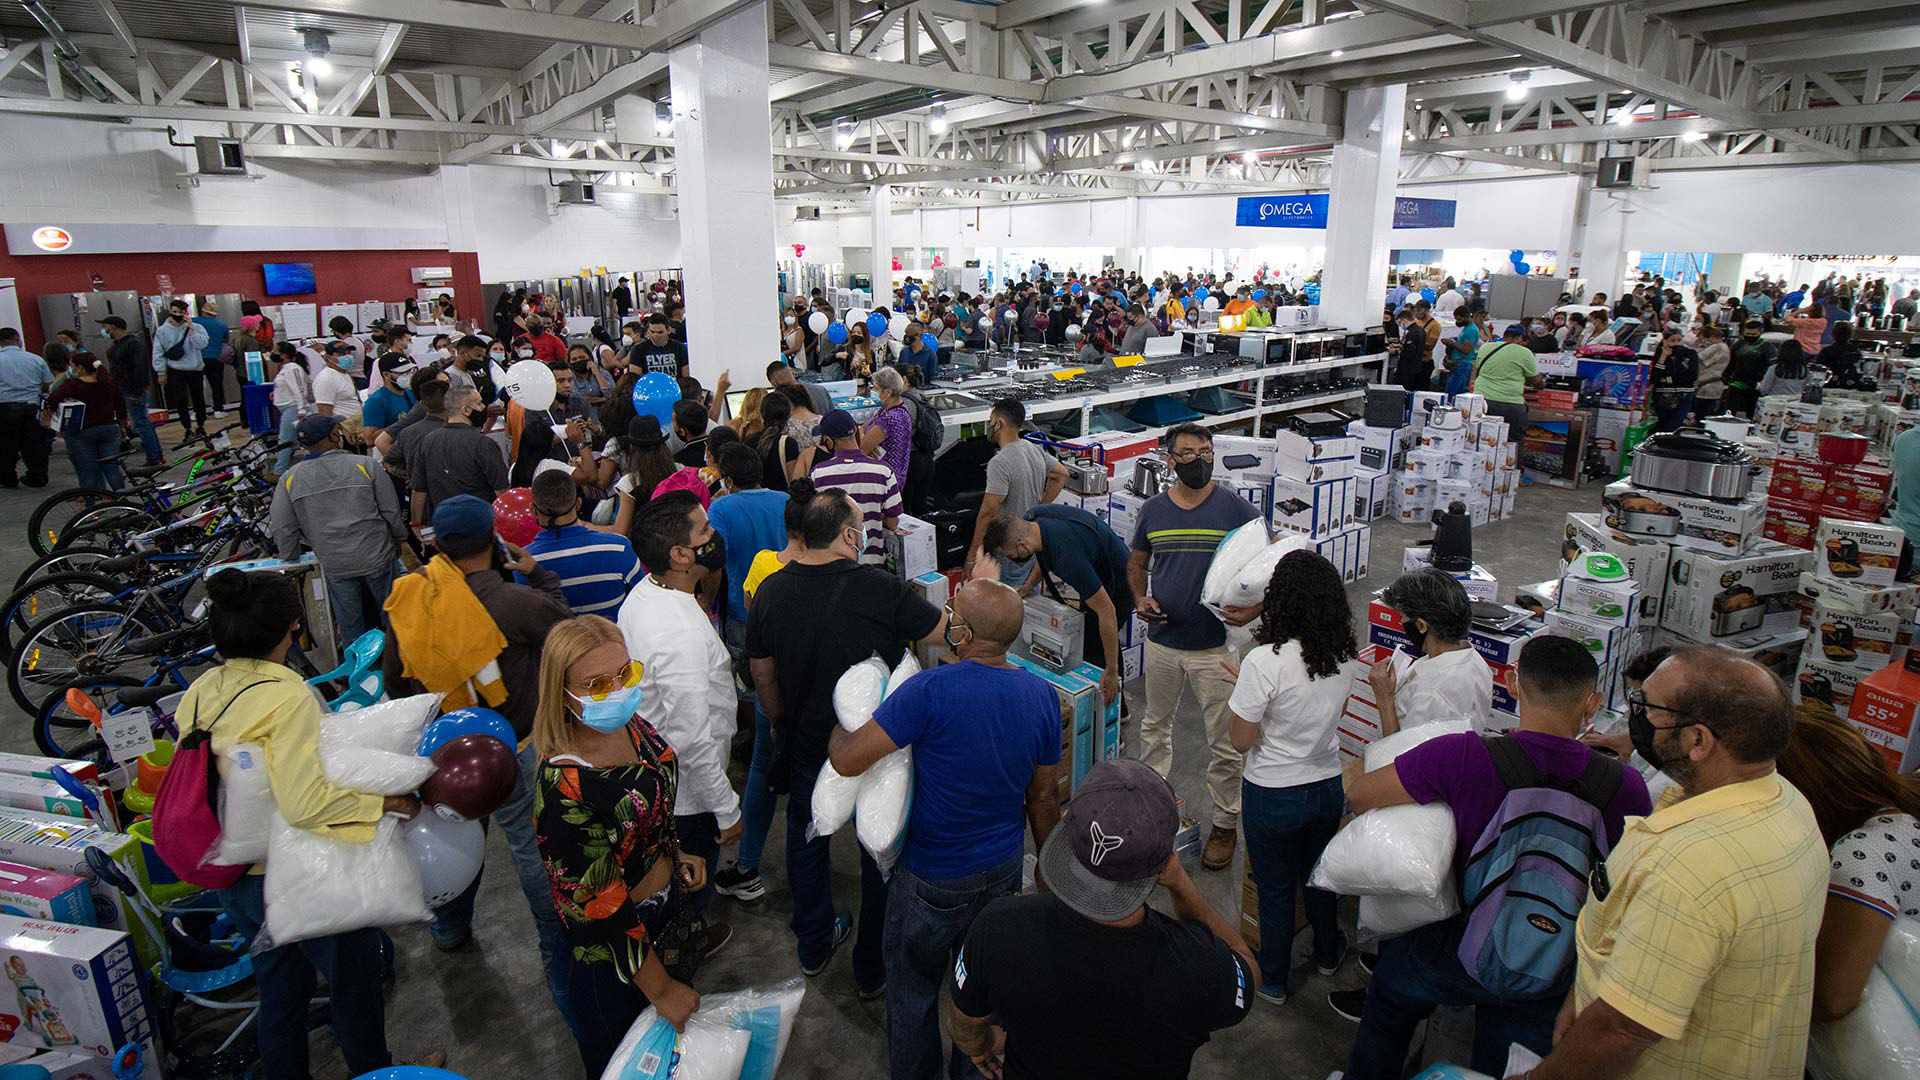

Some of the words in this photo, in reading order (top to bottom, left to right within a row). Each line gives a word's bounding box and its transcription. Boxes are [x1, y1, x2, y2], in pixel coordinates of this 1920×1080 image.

[646, 353, 676, 365] FLYER
[1678, 501, 1724, 515] Hamilton
[1703, 511, 1736, 523] Beach
[1832, 528, 1884, 540] Hamilton
[1860, 538, 1897, 548] Beach
[1746, 561, 1795, 575] Hamilton
[1579, 587, 1612, 600] ROYAL
[1827, 611, 1879, 625] Hamilton
[1559, 619, 1593, 633] ROYAL
[1854, 622, 1891, 633] Beach
[1805, 662, 1857, 681] Hamilton
[1866, 692, 1904, 709] aiwa
[1858, 725, 1896, 745] NETFLIX
